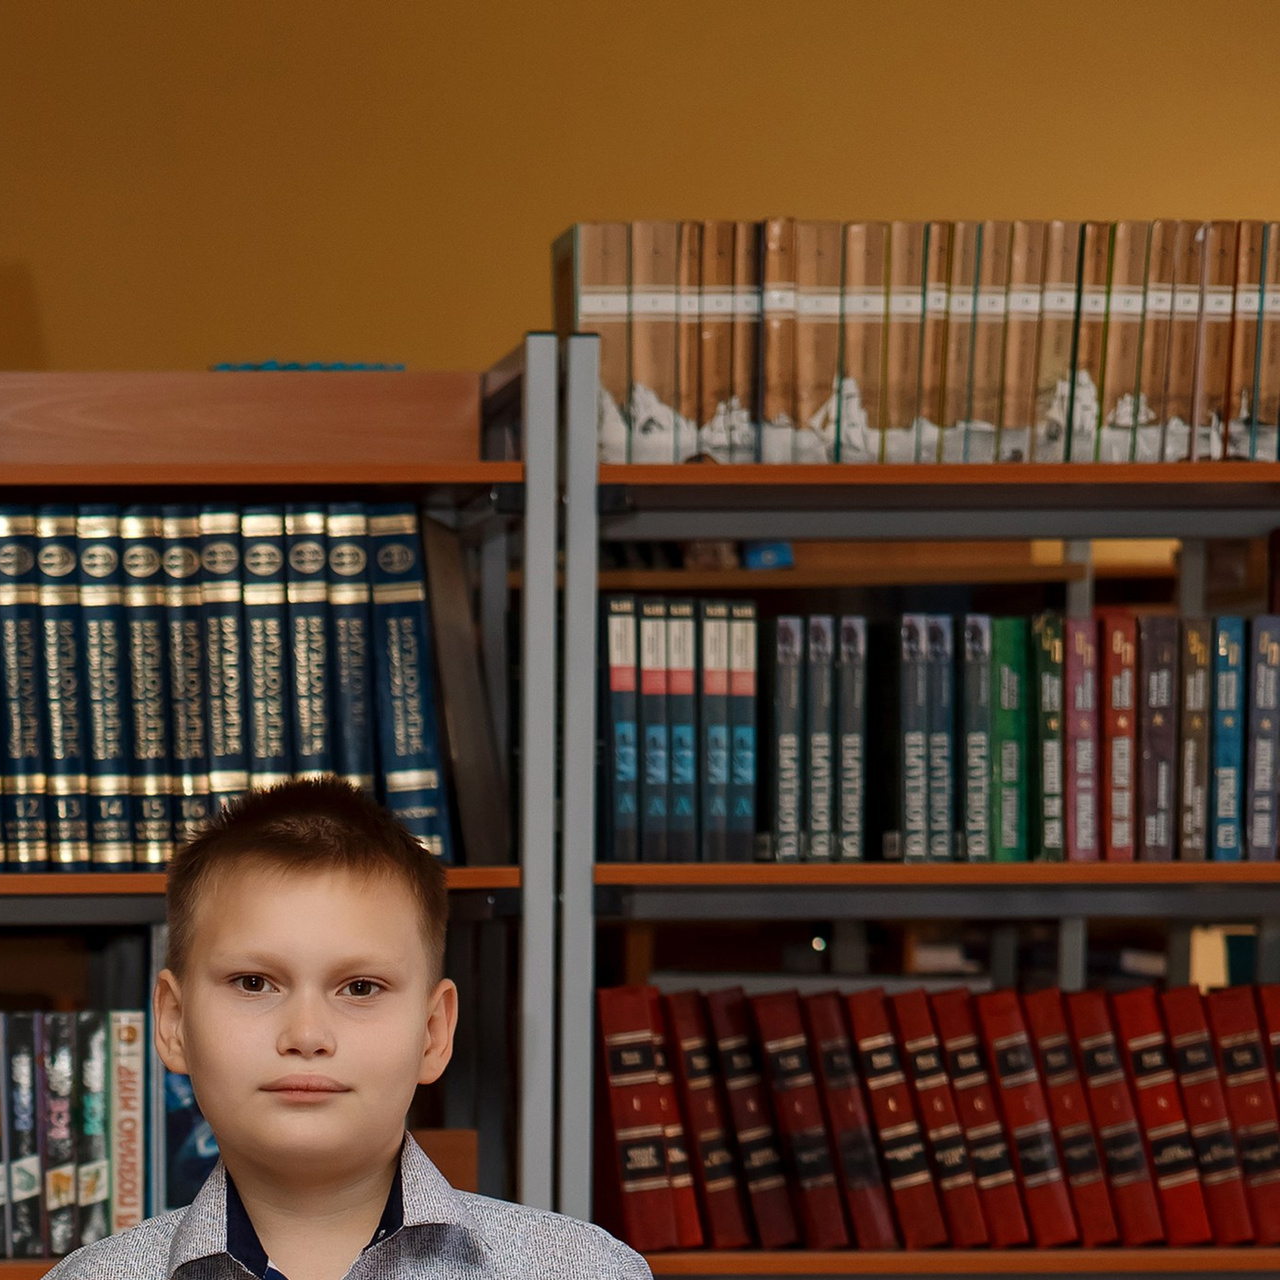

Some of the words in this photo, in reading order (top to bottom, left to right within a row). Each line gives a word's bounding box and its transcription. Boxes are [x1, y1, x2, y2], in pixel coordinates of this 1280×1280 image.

[100, 621, 120, 758] ЭНЦИКЛОПЕДИЯ
[143, 621, 165, 758] ЭНЦИКЛОПЕДИЯ
[220, 616, 243, 754] ЭНЦИКЛОПЕДИЯ
[265, 617, 282, 756] ЭНЦИКЛОПЕДИЯ
[308, 616, 326, 755] ЭНЦИКЛОПЕДИЯ
[401, 617, 423, 754] ЭНЦИКЛОПЕДИЯ
[17, 799, 39, 818] 12
[58, 799, 80, 818] 13
[100, 798, 122, 817] 14
[143, 799, 164, 818] 15
[182, 799, 205, 818] 16
[117, 1065, 135, 1112] МИР
[117, 1118, 136, 1208] ПОЗНАЮ
